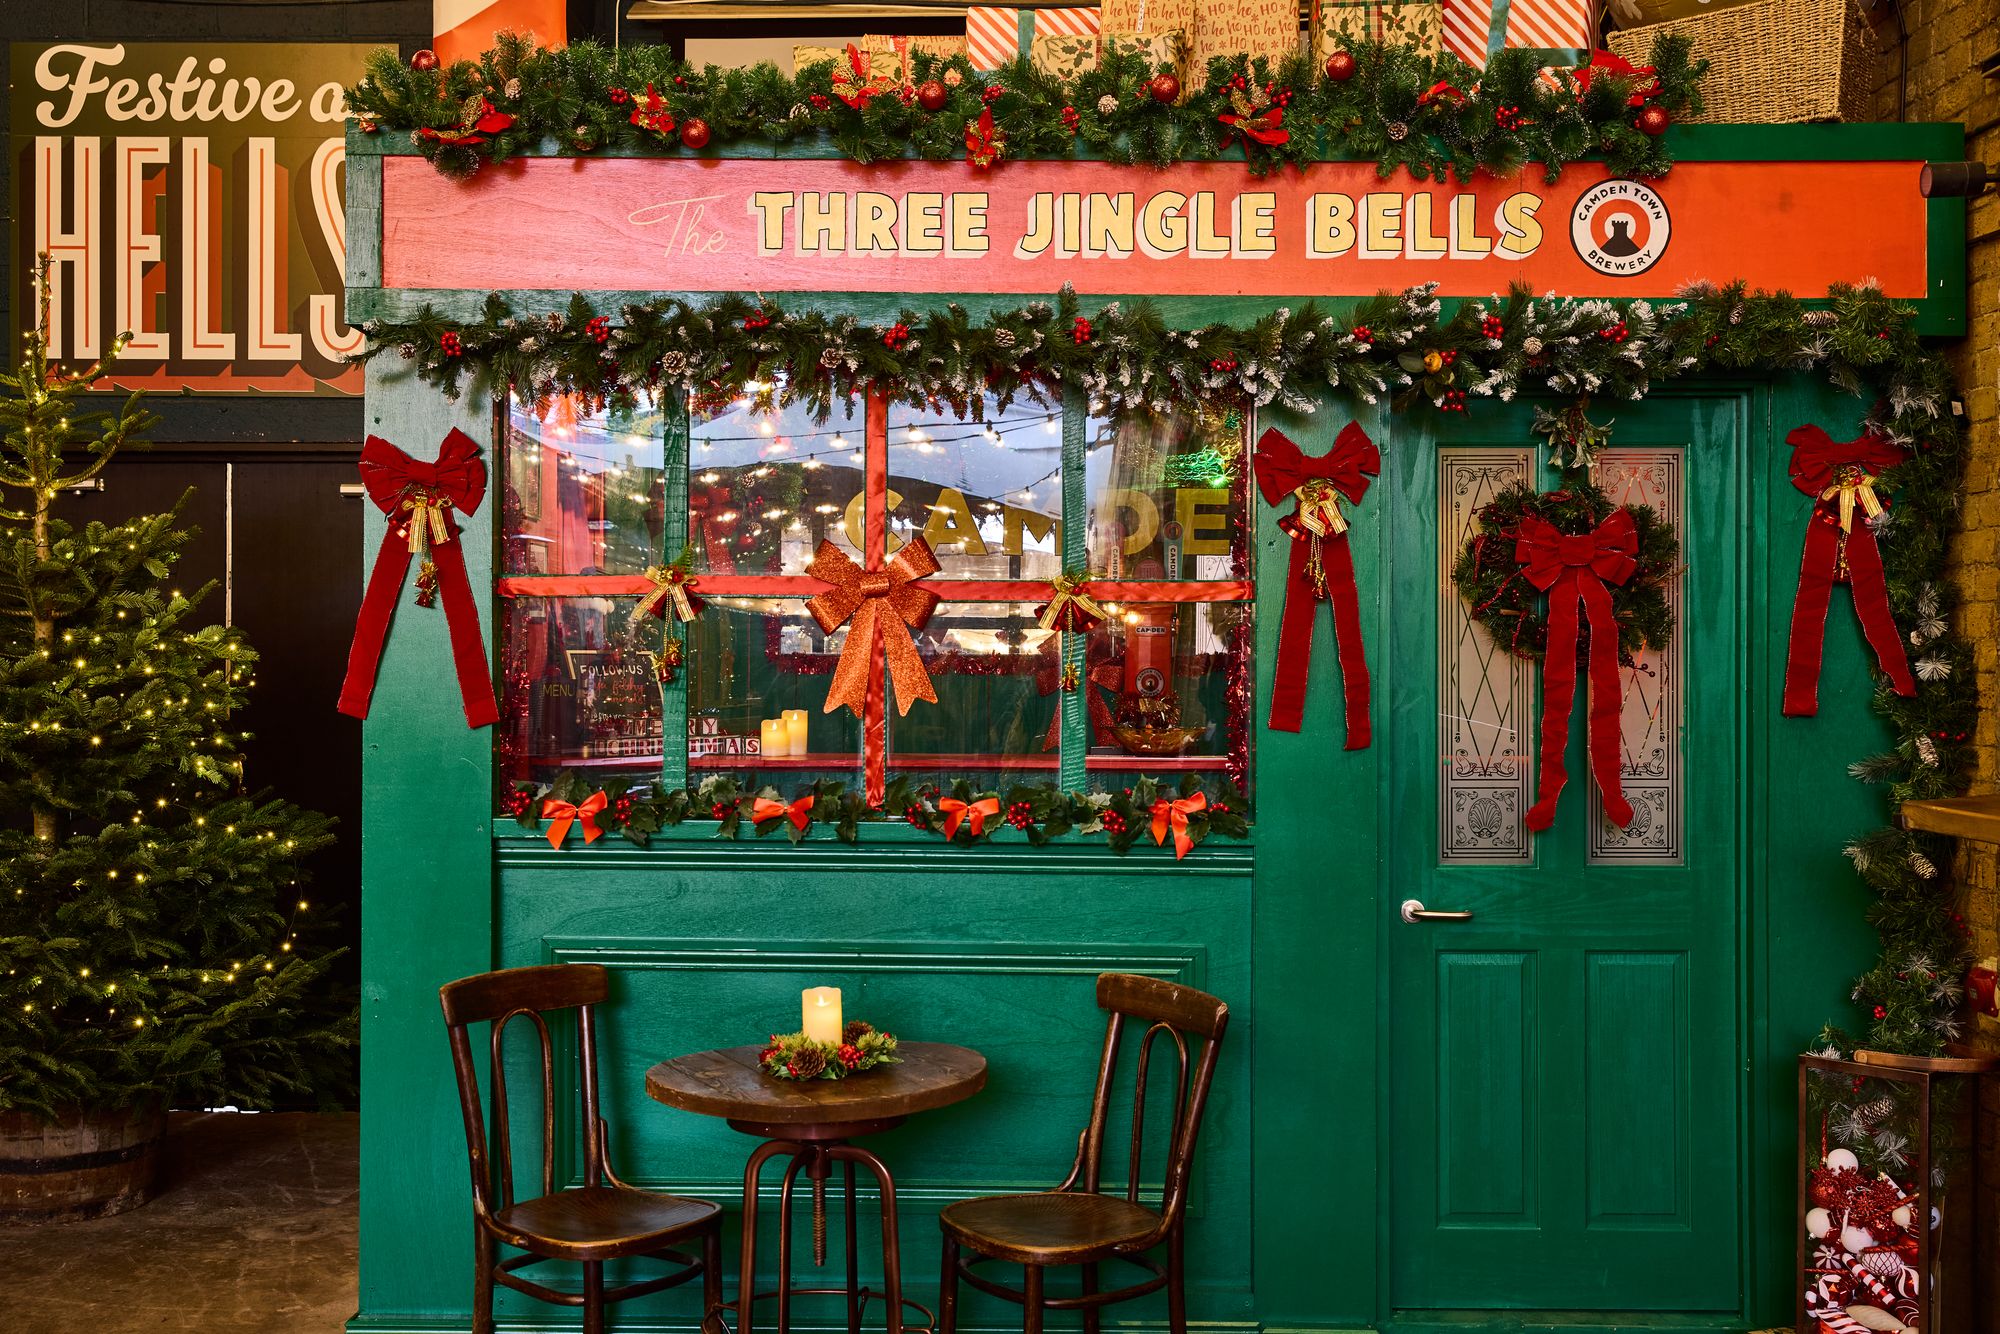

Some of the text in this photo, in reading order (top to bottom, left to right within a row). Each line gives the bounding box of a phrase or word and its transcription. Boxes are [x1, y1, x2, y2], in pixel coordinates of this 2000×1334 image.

[35, 43, 374, 128] Festive a
[1578, 185, 1663, 221] CAMDEN TOWN
[628, 190, 1544, 260] The THREE JINGLE BELLS
[1587, 249, 1653, 271] BREWERY
[628, 664, 644, 675] US
[543, 684, 575, 697] MENU
